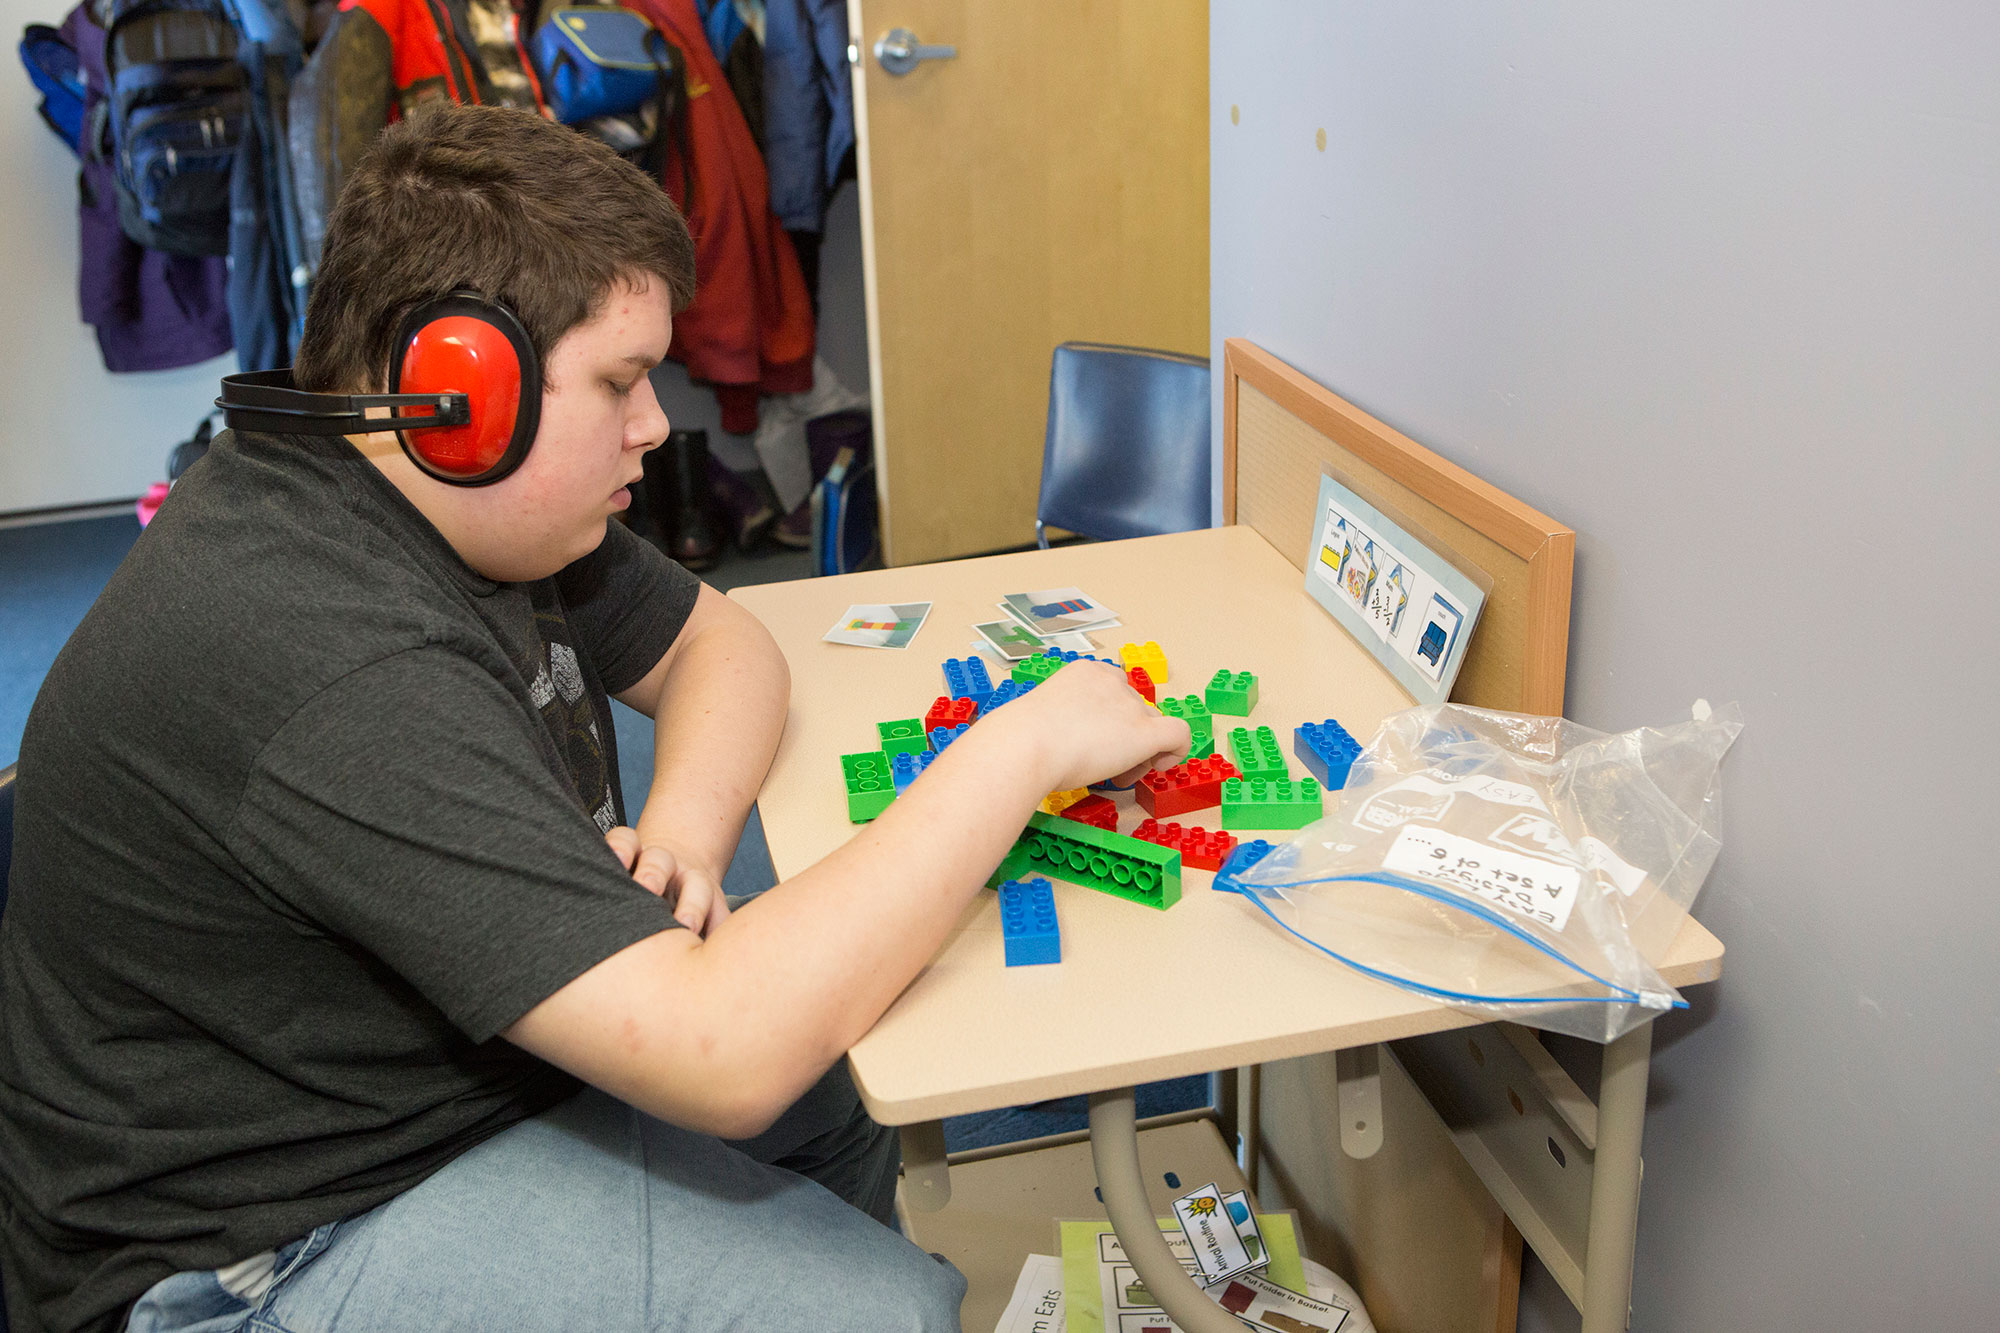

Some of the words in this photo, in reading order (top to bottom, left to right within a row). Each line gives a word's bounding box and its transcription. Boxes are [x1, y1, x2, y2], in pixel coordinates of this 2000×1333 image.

[1456, 857, 1480, 869] of
[1543, 883, 1562, 899] A
[1199, 1219, 1218, 1250] Routine
[1209, 1248, 1229, 1272] Arrival
[1243, 1276, 1258, 1285] Put
[1259, 1283, 1286, 1298] Folder
[1287, 1294, 1296, 1302] in
[1034, 1289, 1062, 1316] Eats
